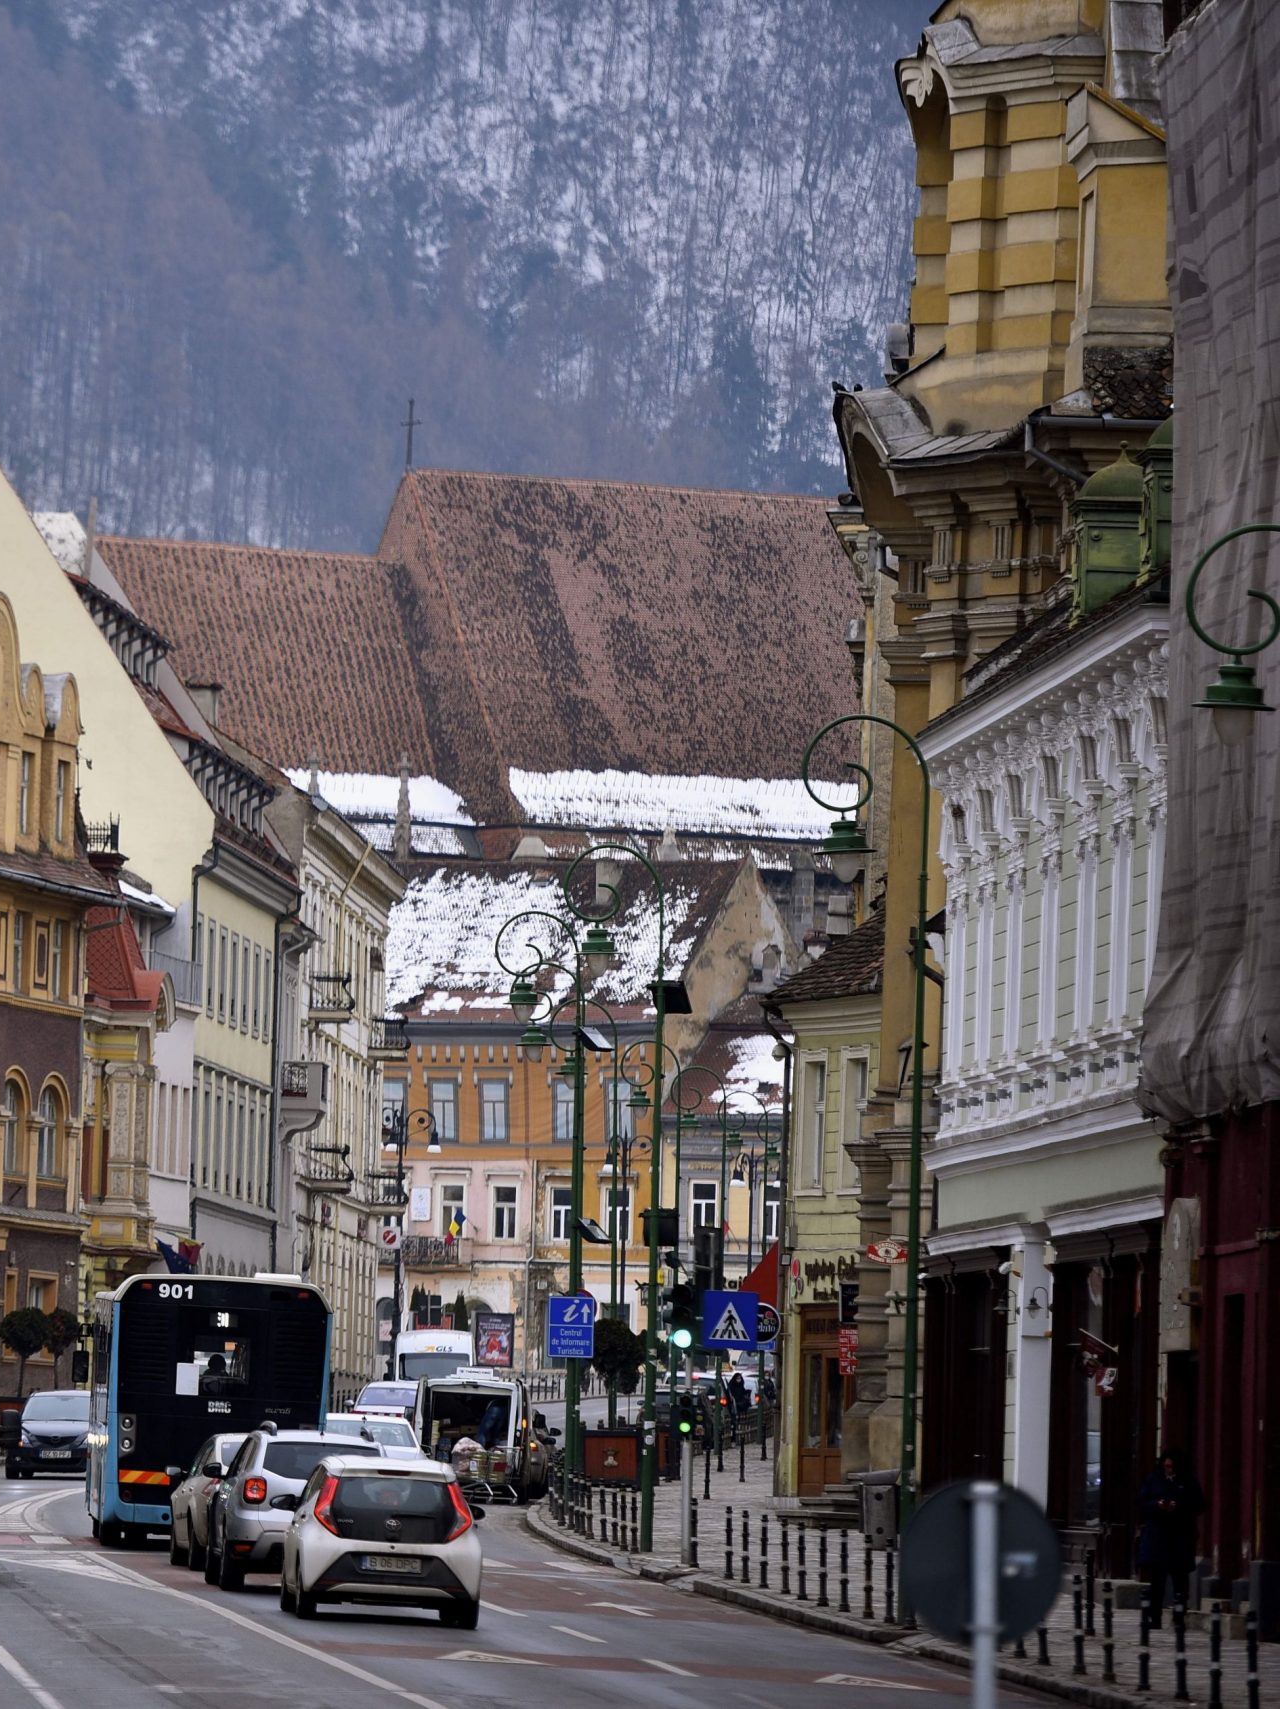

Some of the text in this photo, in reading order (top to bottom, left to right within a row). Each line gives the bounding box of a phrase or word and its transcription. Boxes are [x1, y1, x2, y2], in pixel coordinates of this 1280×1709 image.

[158, 1283, 194, 1300] 901
[560, 1328, 582, 1336] Centrul
[561, 1338, 590, 1346] Informare
[435, 1345, 453, 1353] GLS
[208, 1401, 232, 1414] BMC
[369, 1557, 418, 1570] B 06 DPC
